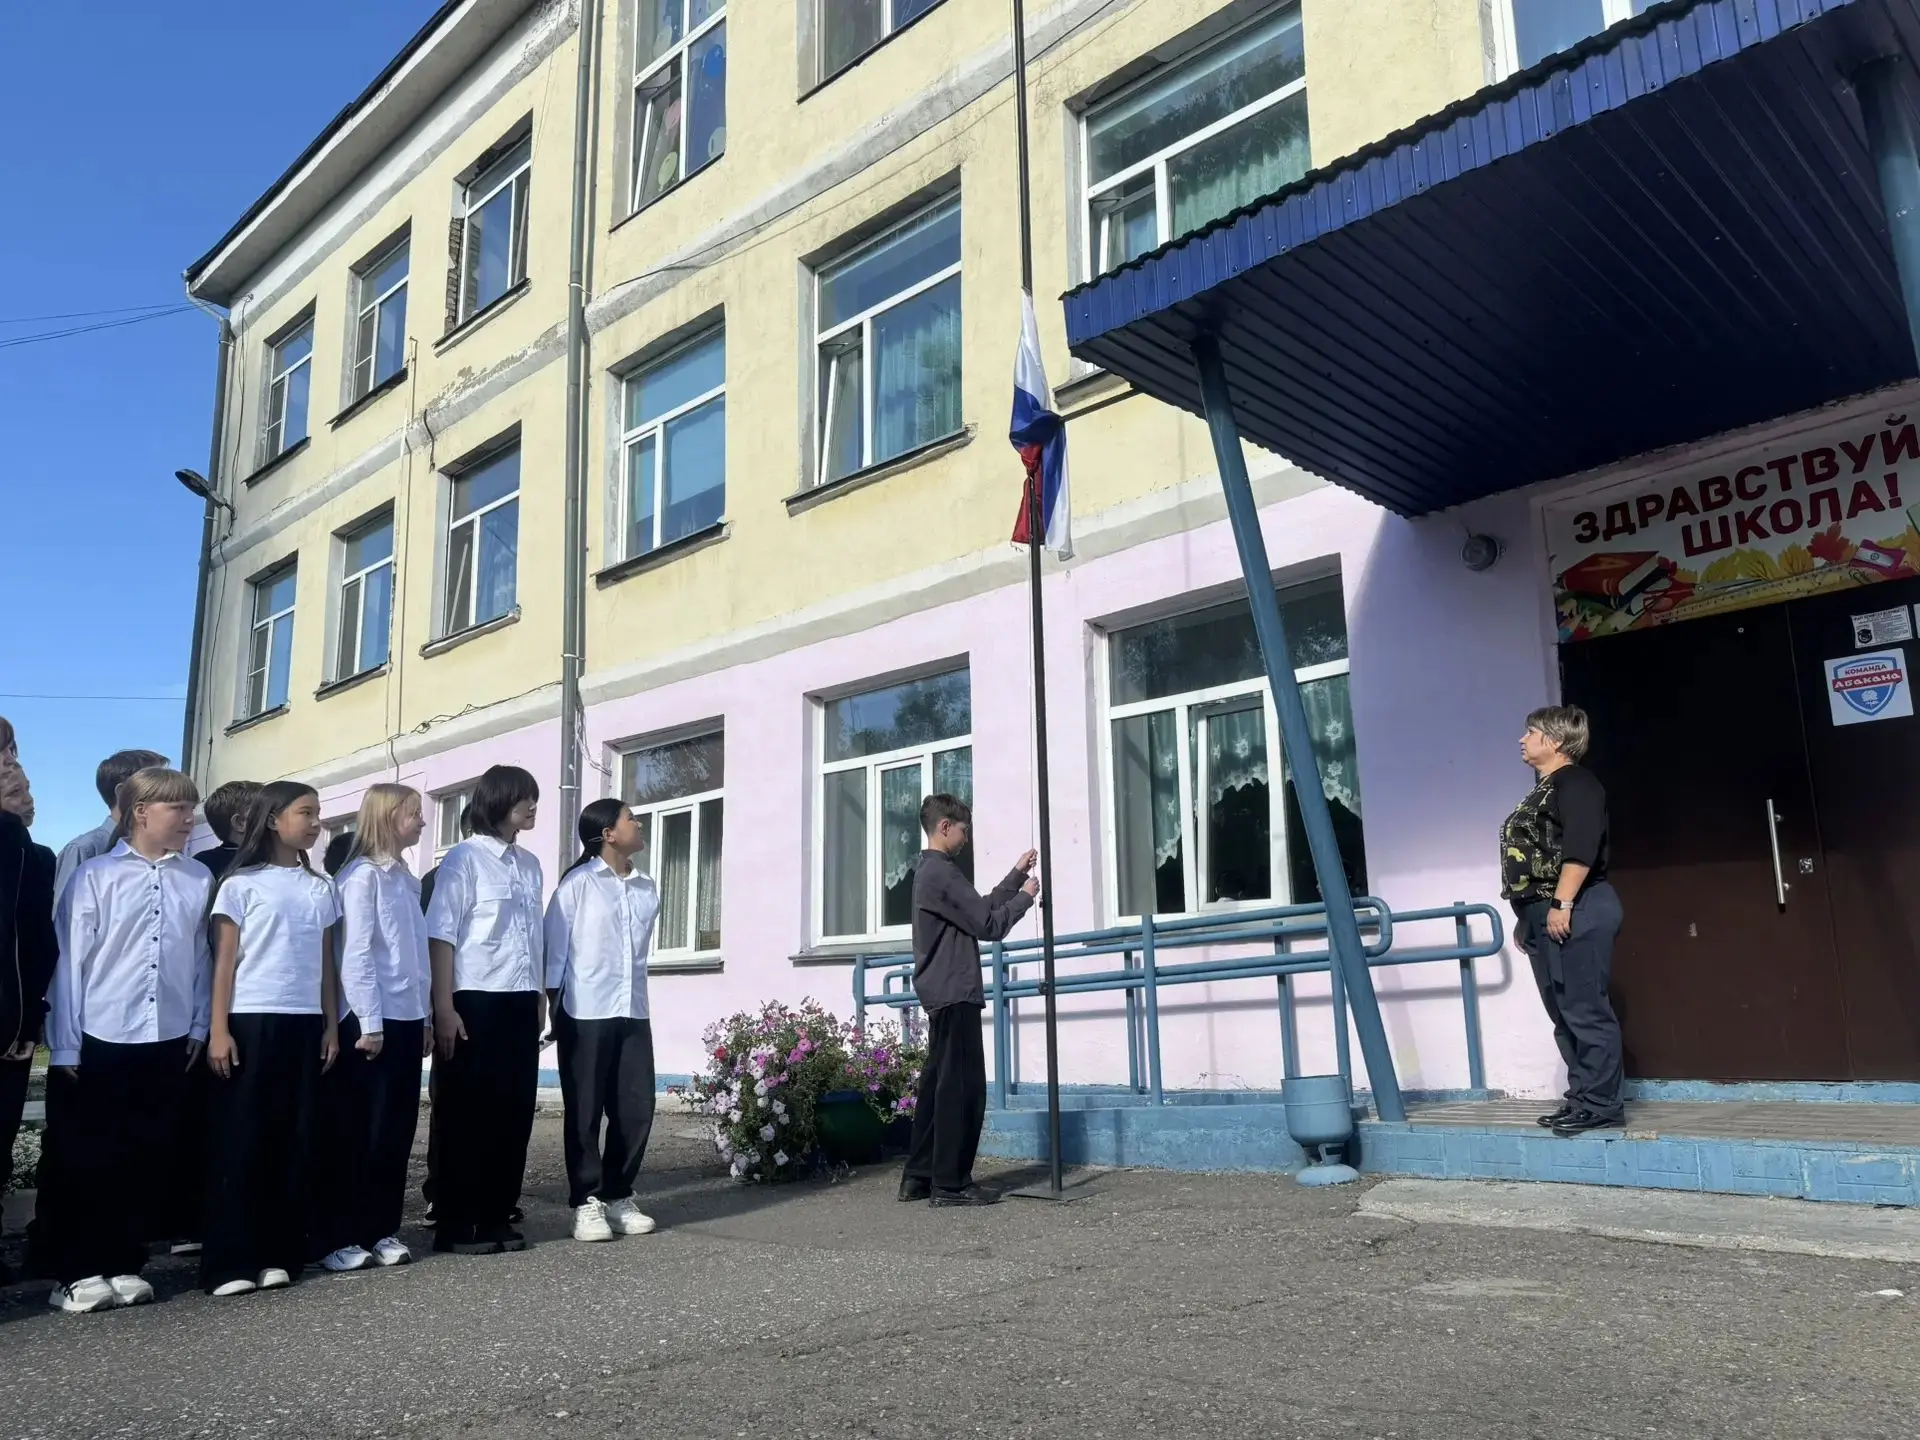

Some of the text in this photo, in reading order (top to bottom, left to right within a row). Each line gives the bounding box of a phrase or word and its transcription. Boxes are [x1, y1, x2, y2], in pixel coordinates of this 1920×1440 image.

[1573, 413, 1920, 544] ЗДРАВСТВУЙ
[1681, 472, 1903, 557] ШКОЛА!
[1845, 664, 1887, 675] КОМАНДА
